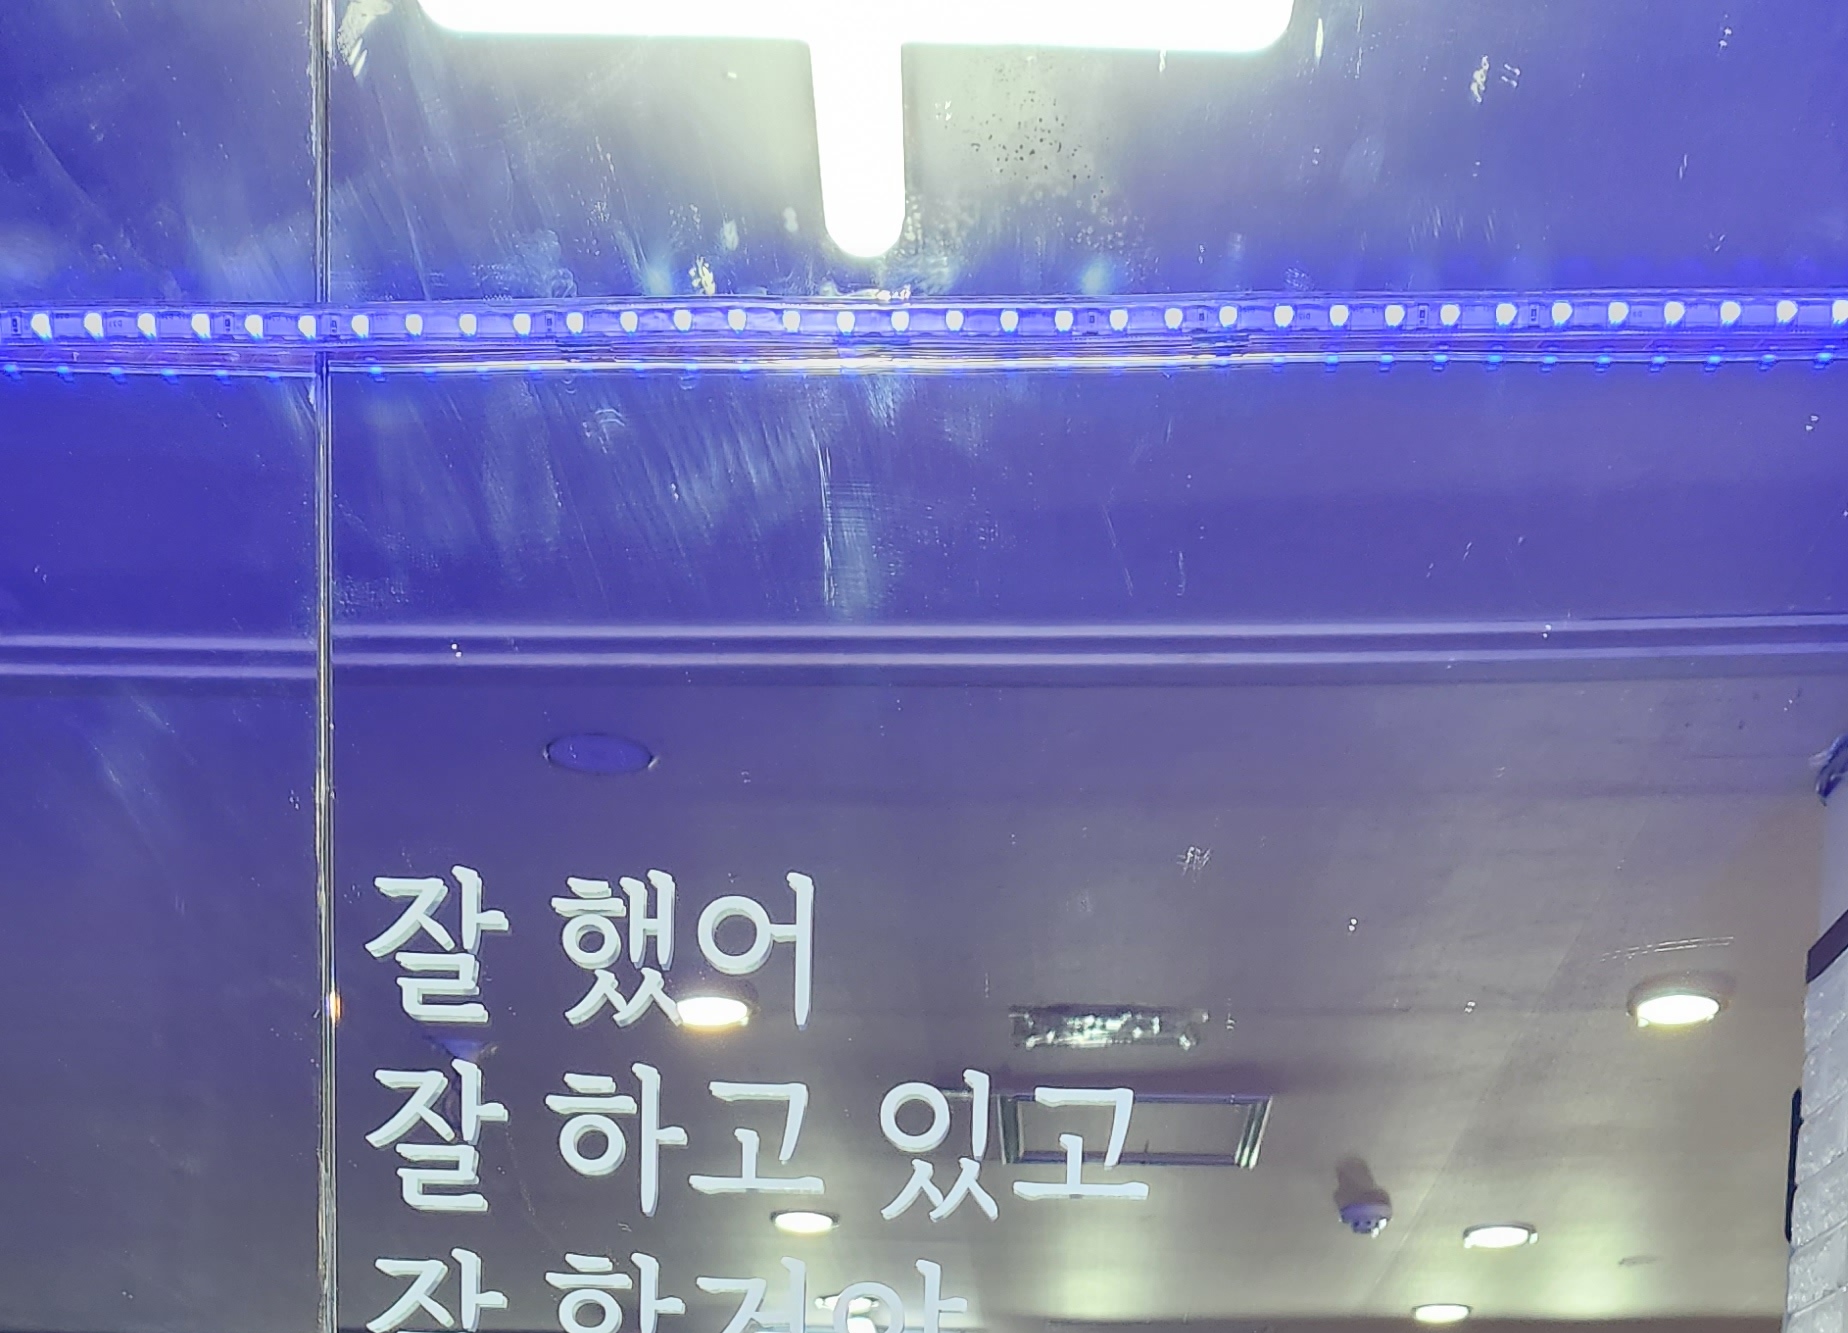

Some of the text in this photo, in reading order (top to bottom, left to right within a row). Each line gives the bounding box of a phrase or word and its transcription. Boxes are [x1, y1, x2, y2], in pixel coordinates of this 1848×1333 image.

[366, 865, 815, 1030] 잘 했어
[366, 1058, 1149, 1222] 잘 하고 있고
